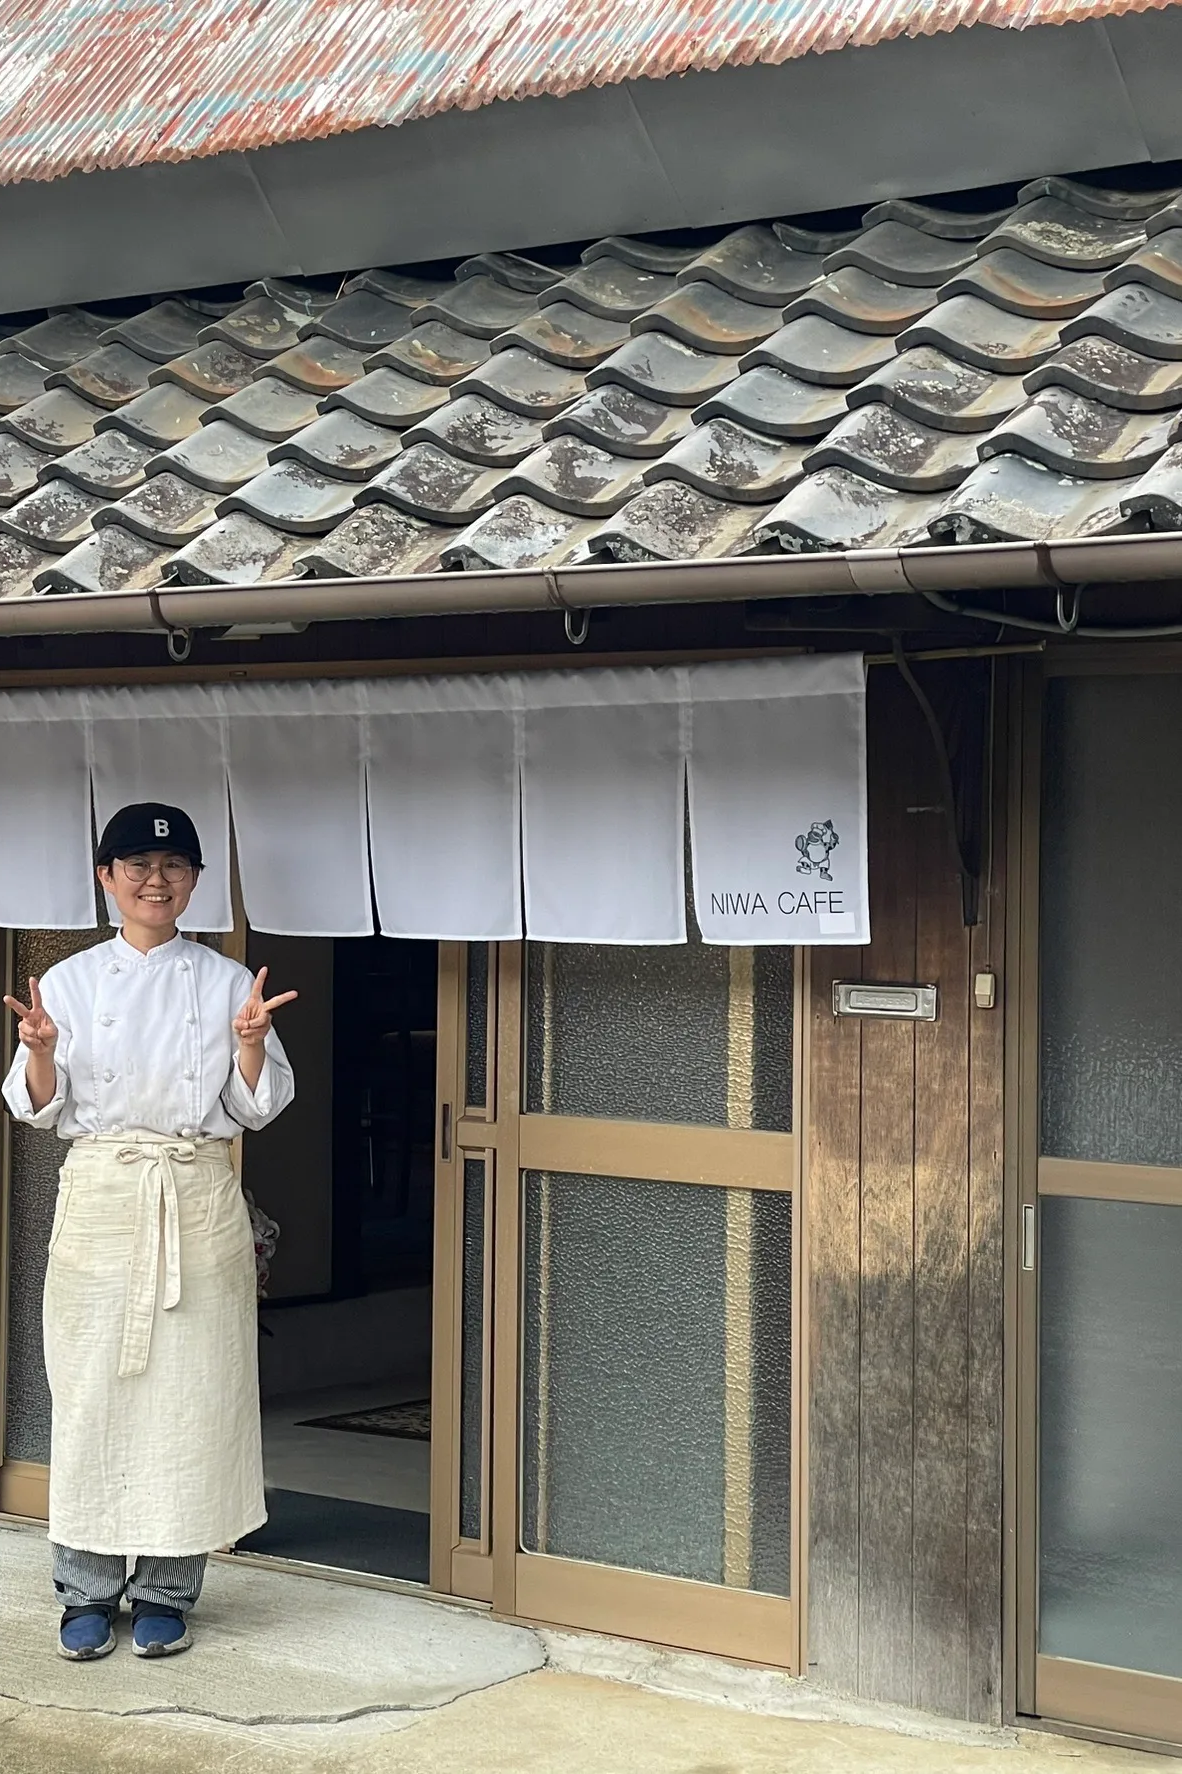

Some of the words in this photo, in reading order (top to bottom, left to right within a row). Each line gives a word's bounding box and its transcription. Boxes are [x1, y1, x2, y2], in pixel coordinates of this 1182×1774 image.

[153, 819, 170, 837] B
[711, 892, 768, 915] NIWA
[777, 891, 845, 915] CAFE
